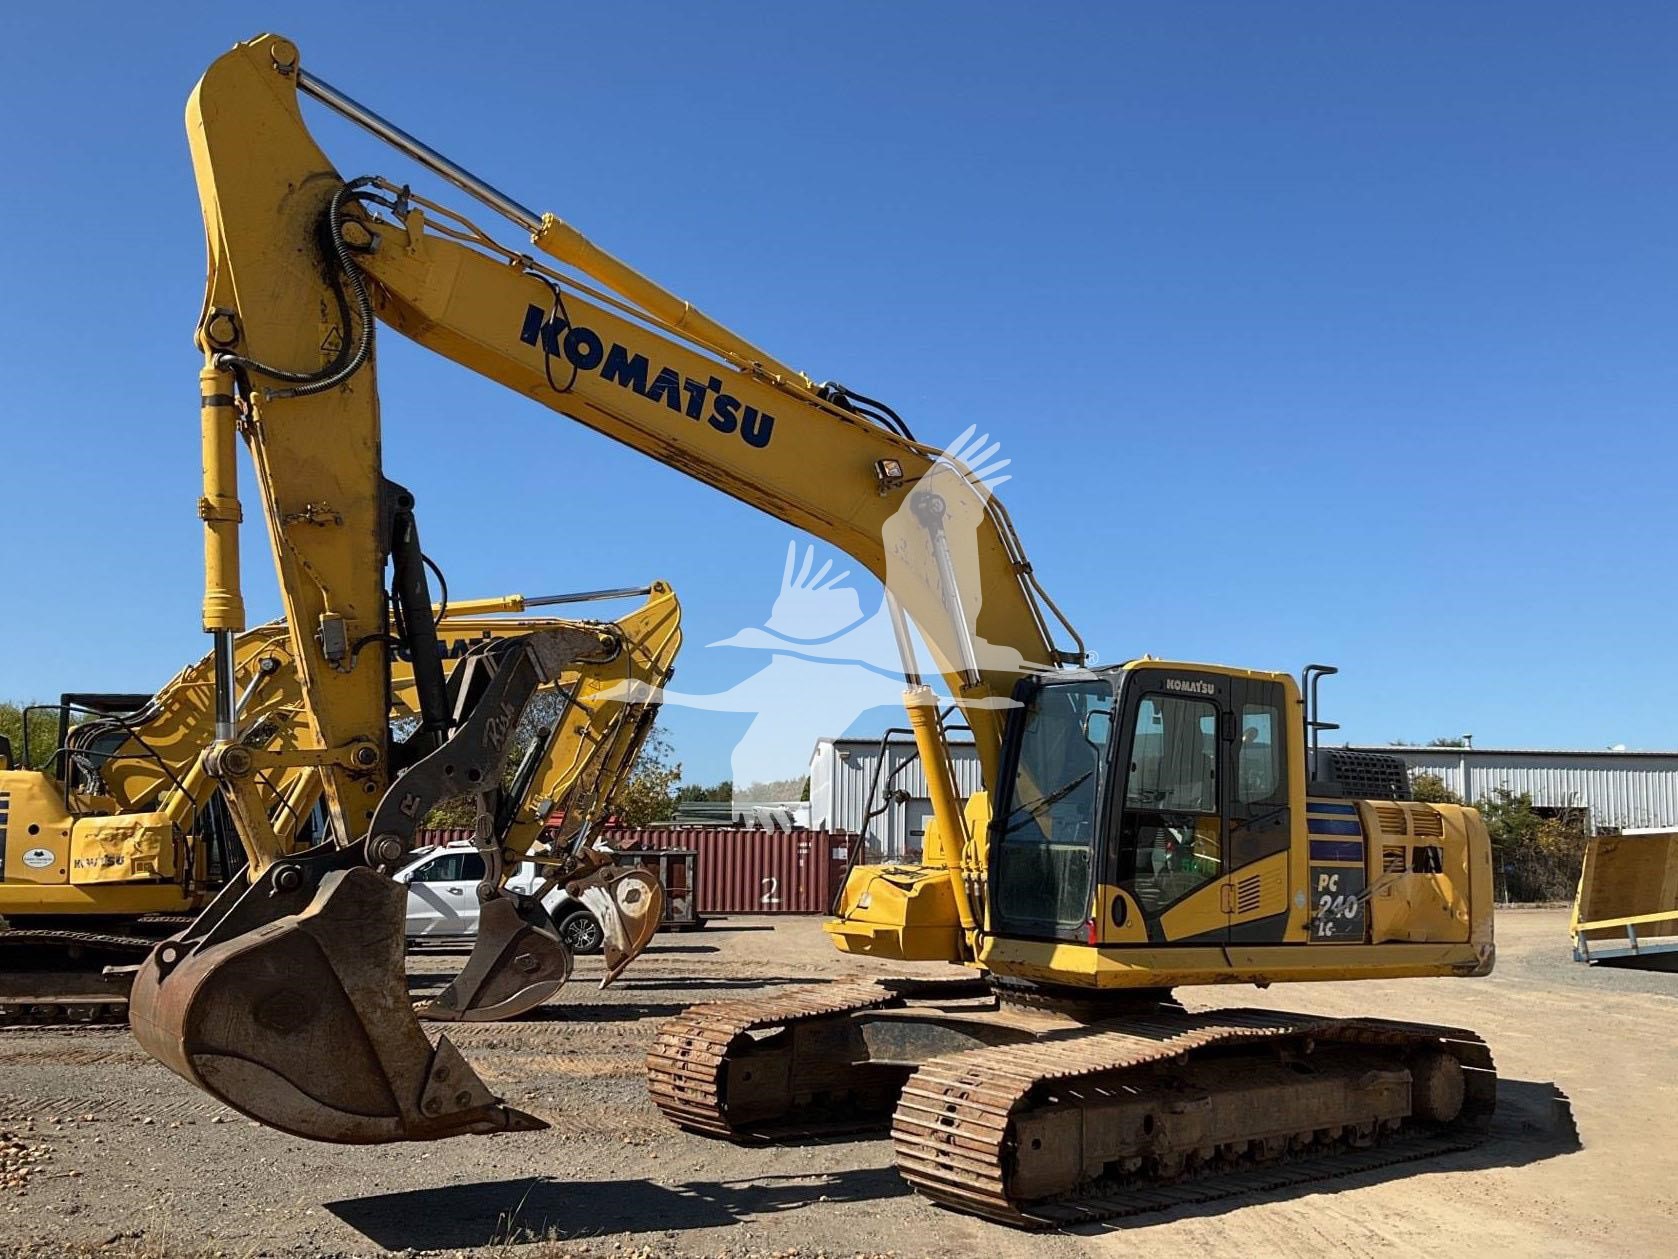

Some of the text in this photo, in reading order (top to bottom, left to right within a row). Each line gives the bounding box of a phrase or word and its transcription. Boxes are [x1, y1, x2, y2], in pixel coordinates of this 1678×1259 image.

[520, 303, 775, 449] KOMATSU
[1166, 678, 1215, 695] KOMATSU
[761, 877, 780, 903] 2
[1318, 874, 1339, 892] PC
[1317, 894, 1358, 919] 240
